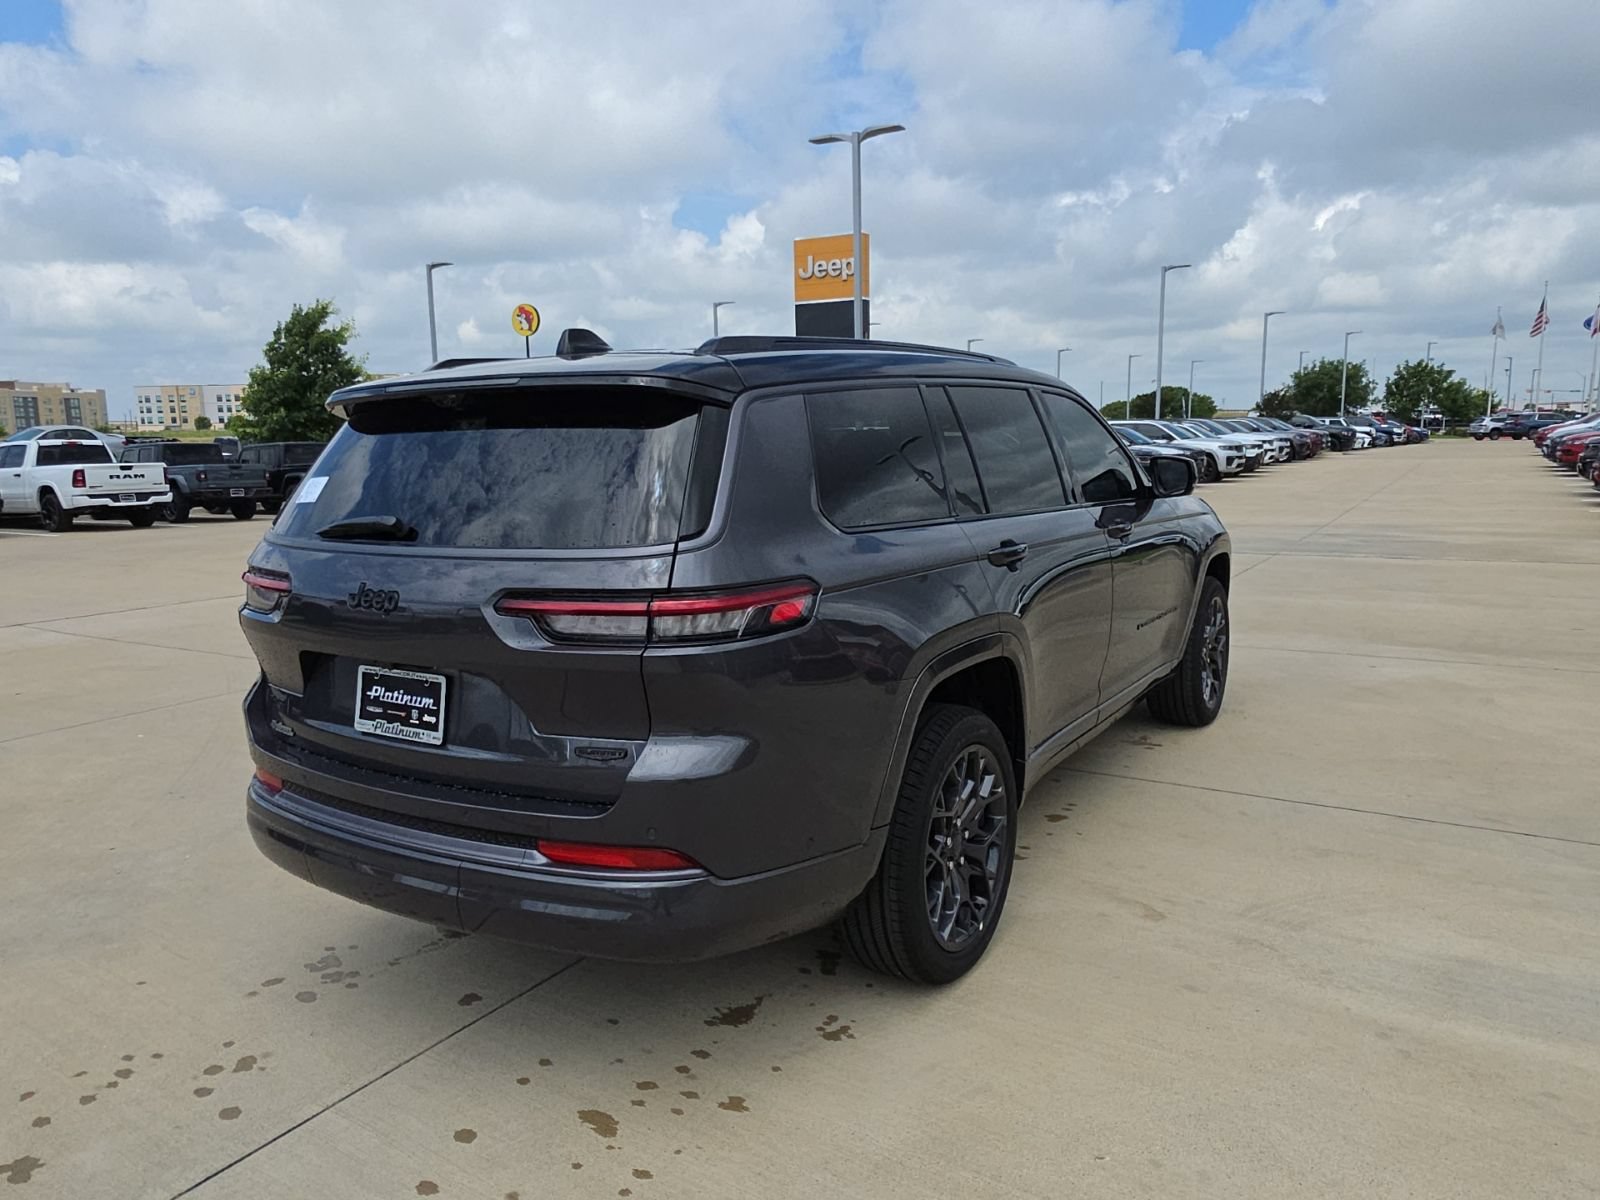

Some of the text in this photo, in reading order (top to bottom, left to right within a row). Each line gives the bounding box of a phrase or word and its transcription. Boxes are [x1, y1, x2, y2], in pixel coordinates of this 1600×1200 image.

[798, 255, 855, 281] Jeep
[347, 582, 400, 615] Jeep
[366, 685, 437, 709] Platinum
[374, 720, 424, 740] Platinum
